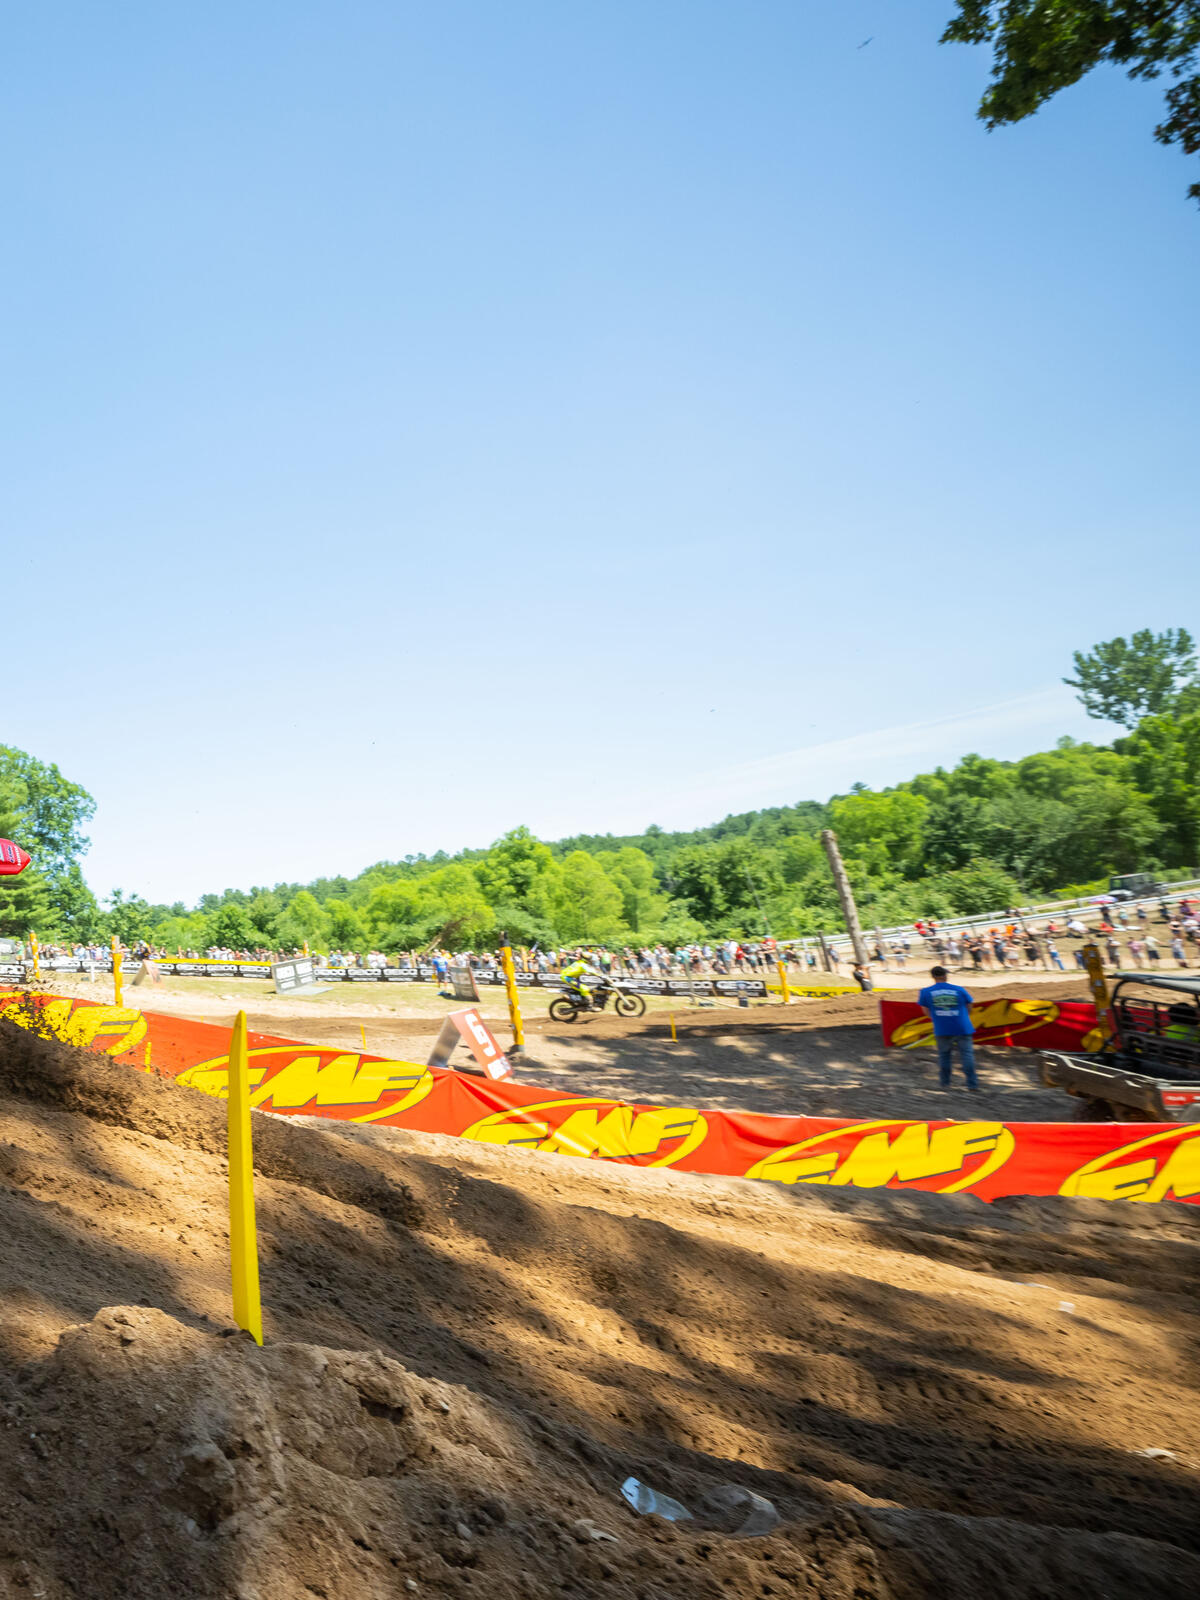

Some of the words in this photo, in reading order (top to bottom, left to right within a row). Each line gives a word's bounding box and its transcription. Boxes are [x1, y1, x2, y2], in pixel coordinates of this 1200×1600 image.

[188, 1053, 428, 1109] FMF
[474, 1106, 698, 1158] FMF
[761, 1121, 1003, 1188] FMF
[1076, 1139, 1200, 1202] FM
